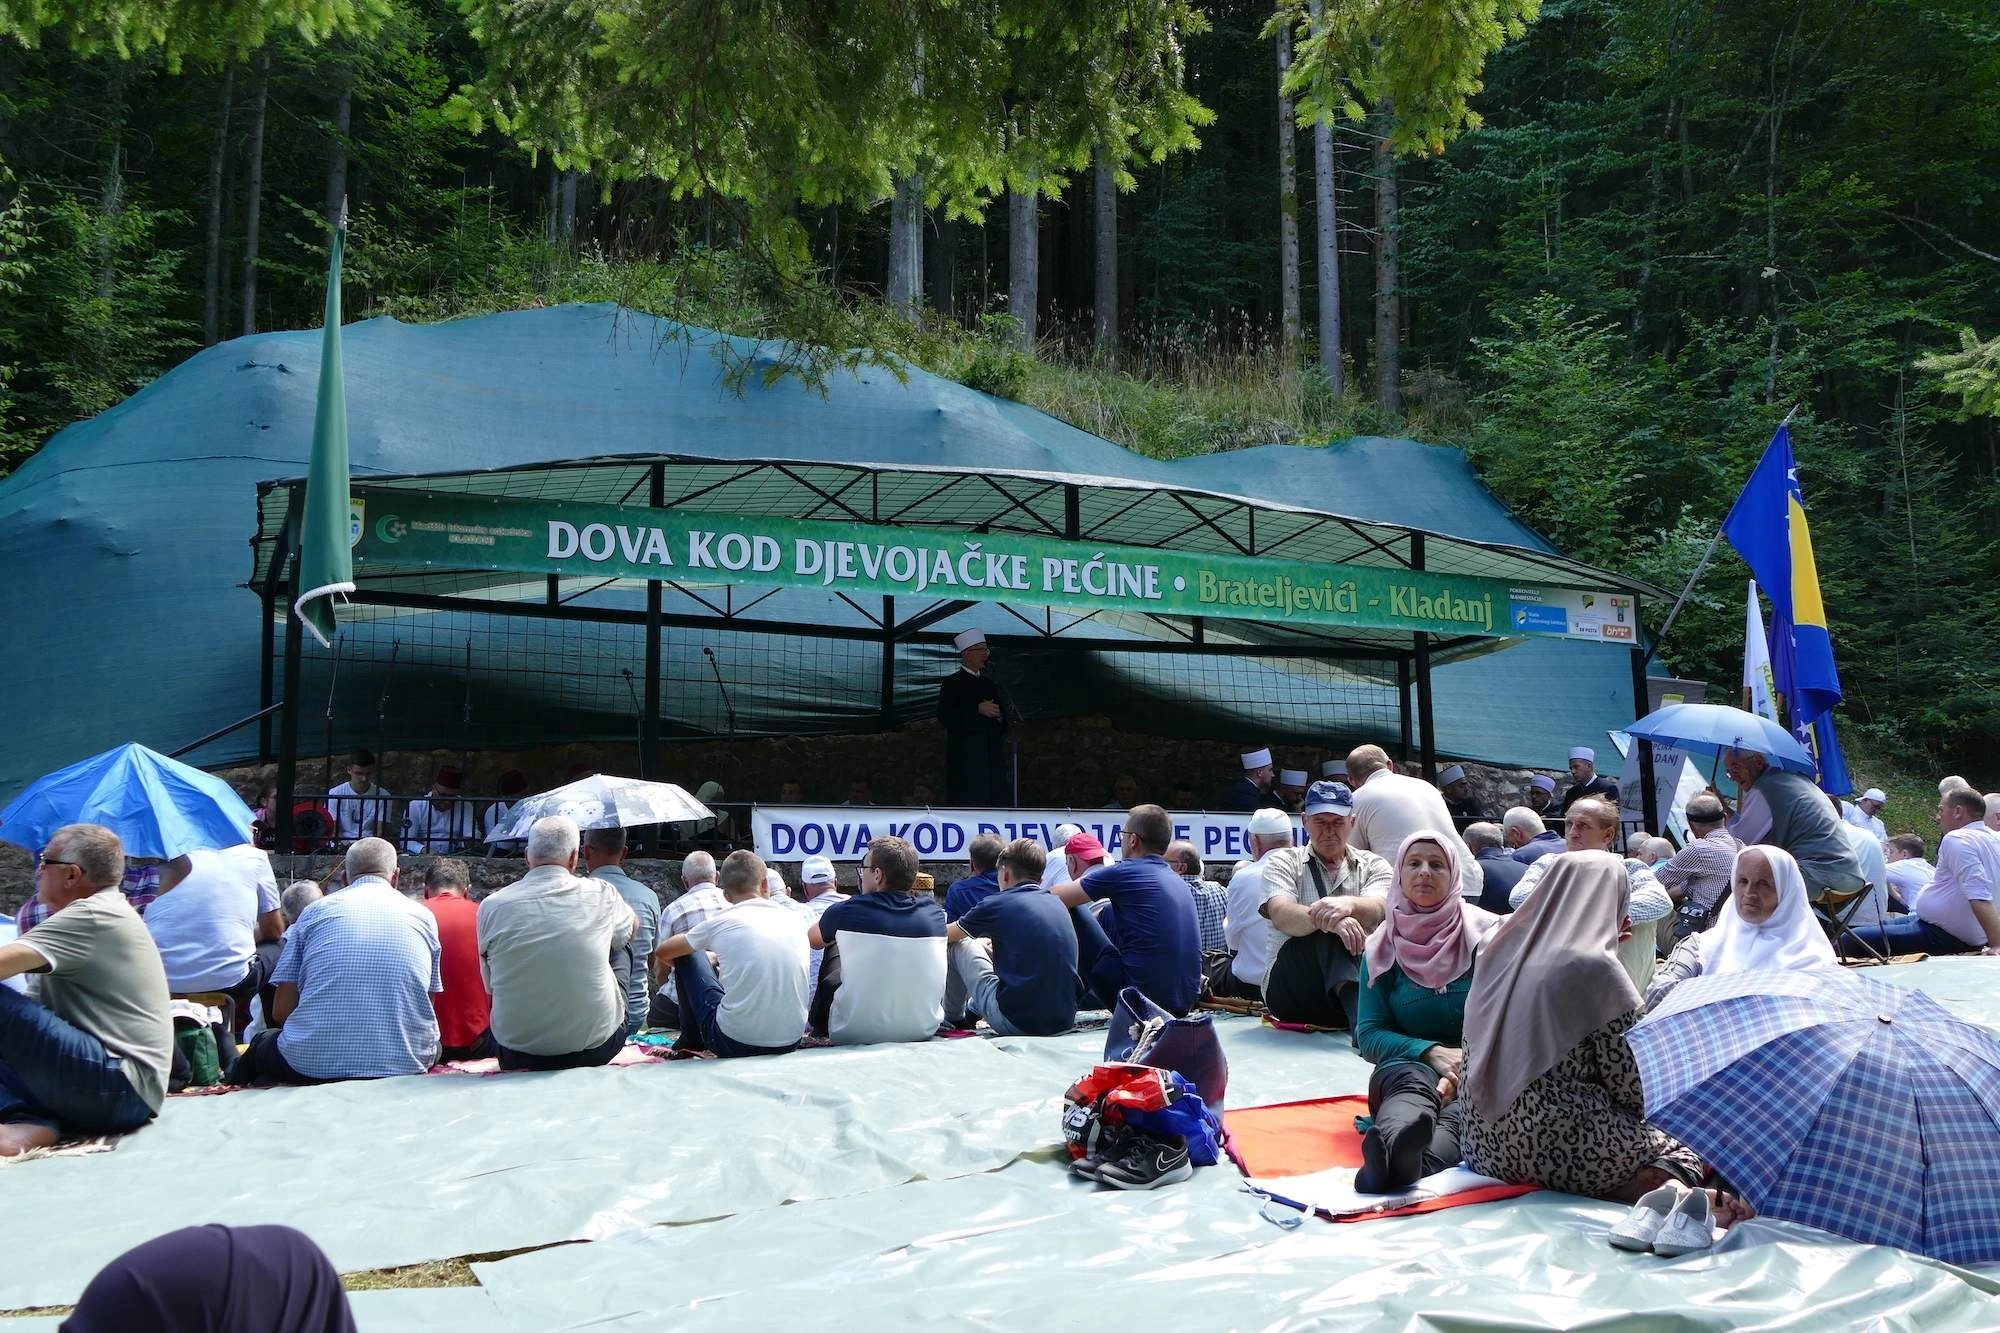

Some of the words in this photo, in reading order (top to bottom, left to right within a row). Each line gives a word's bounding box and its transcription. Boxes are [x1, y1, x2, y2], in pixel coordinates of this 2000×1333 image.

[546, 520, 675, 566] DOVA
[687, 530, 782, 572] KOD
[794, 538, 1032, 592] DJEVOJAČKE
[1042, 551, 1164, 600] PEĆINE
[1388, 583, 1493, 632] Kladanj
[771, 823, 870, 855] DOVA
